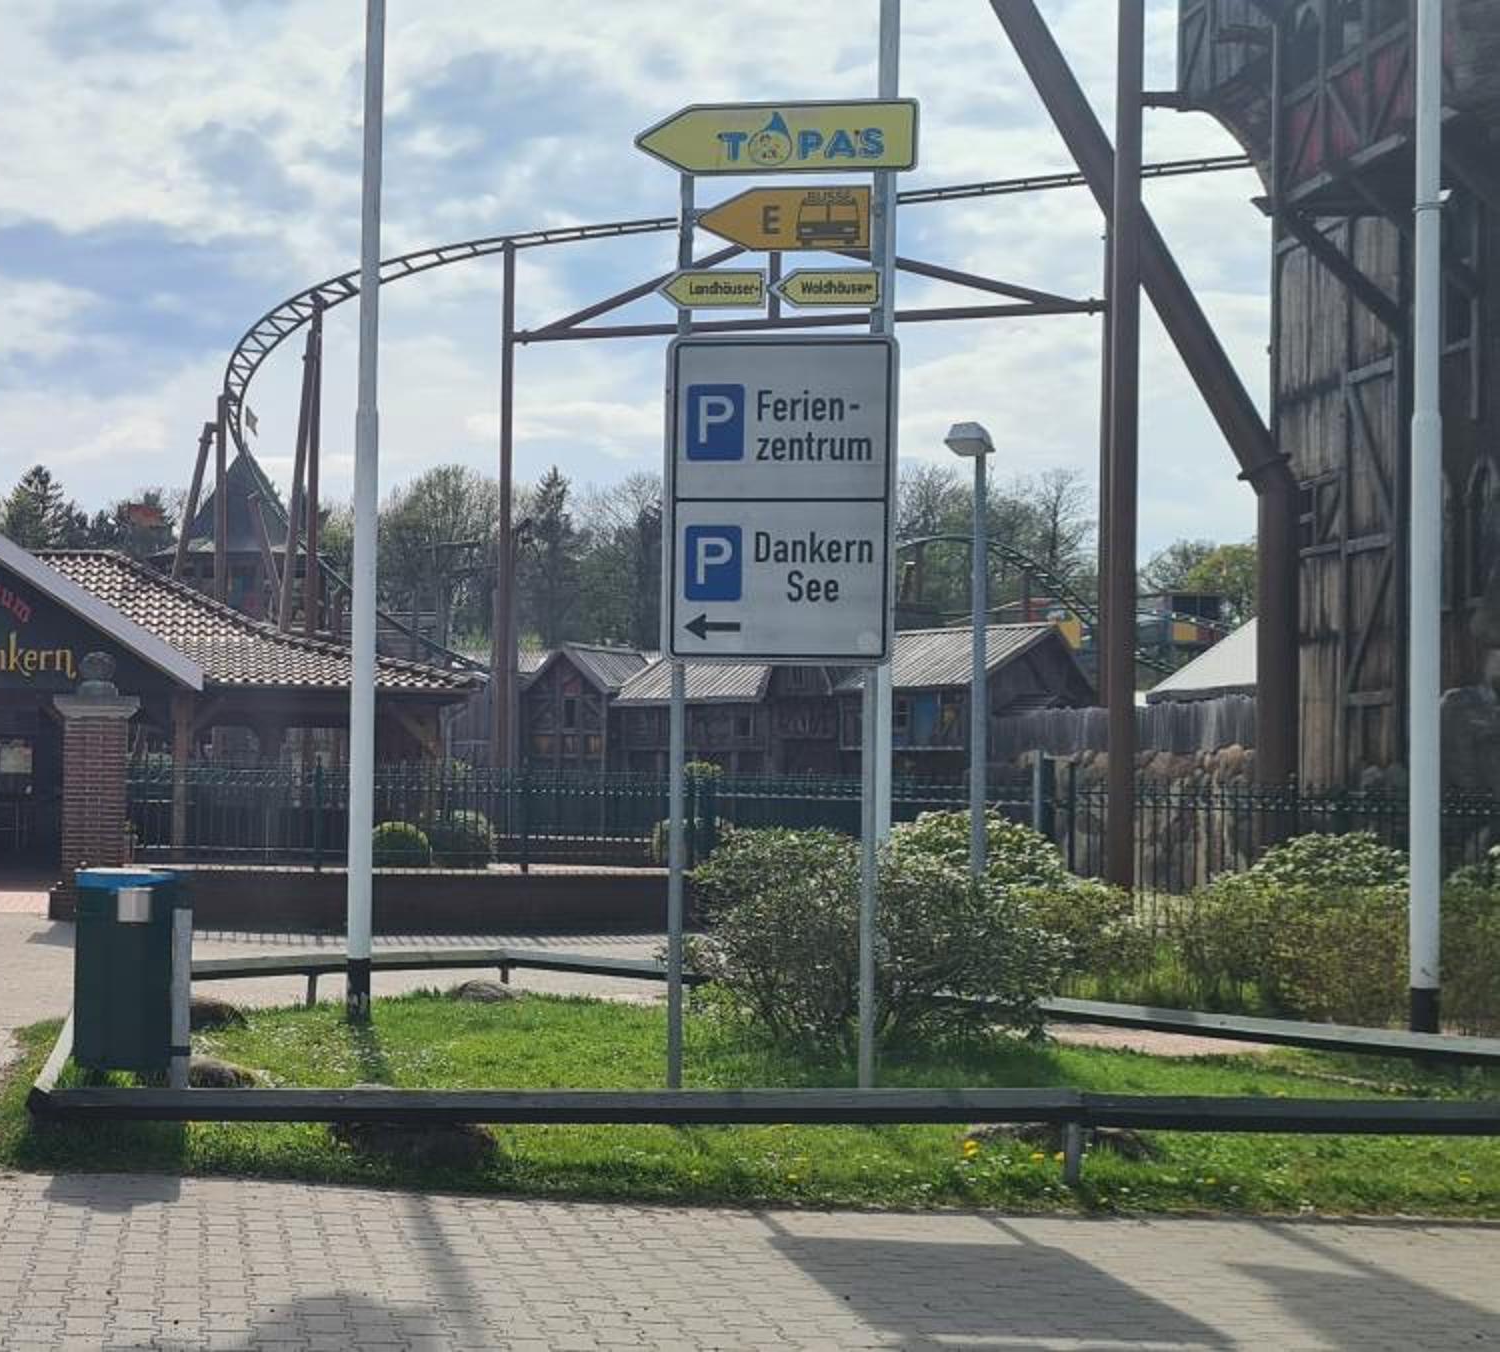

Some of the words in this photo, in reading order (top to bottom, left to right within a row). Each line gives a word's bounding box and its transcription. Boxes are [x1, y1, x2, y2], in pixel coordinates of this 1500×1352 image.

[762, 205, 780, 235] E
[699, 395, 736, 444] P
[756, 389, 861, 422] Ferien-
[756, 431, 873, 462] zentrum
[696, 537, 733, 585] P
[754, 531, 874, 564] Dankern
[786, 569, 840, 603] See
